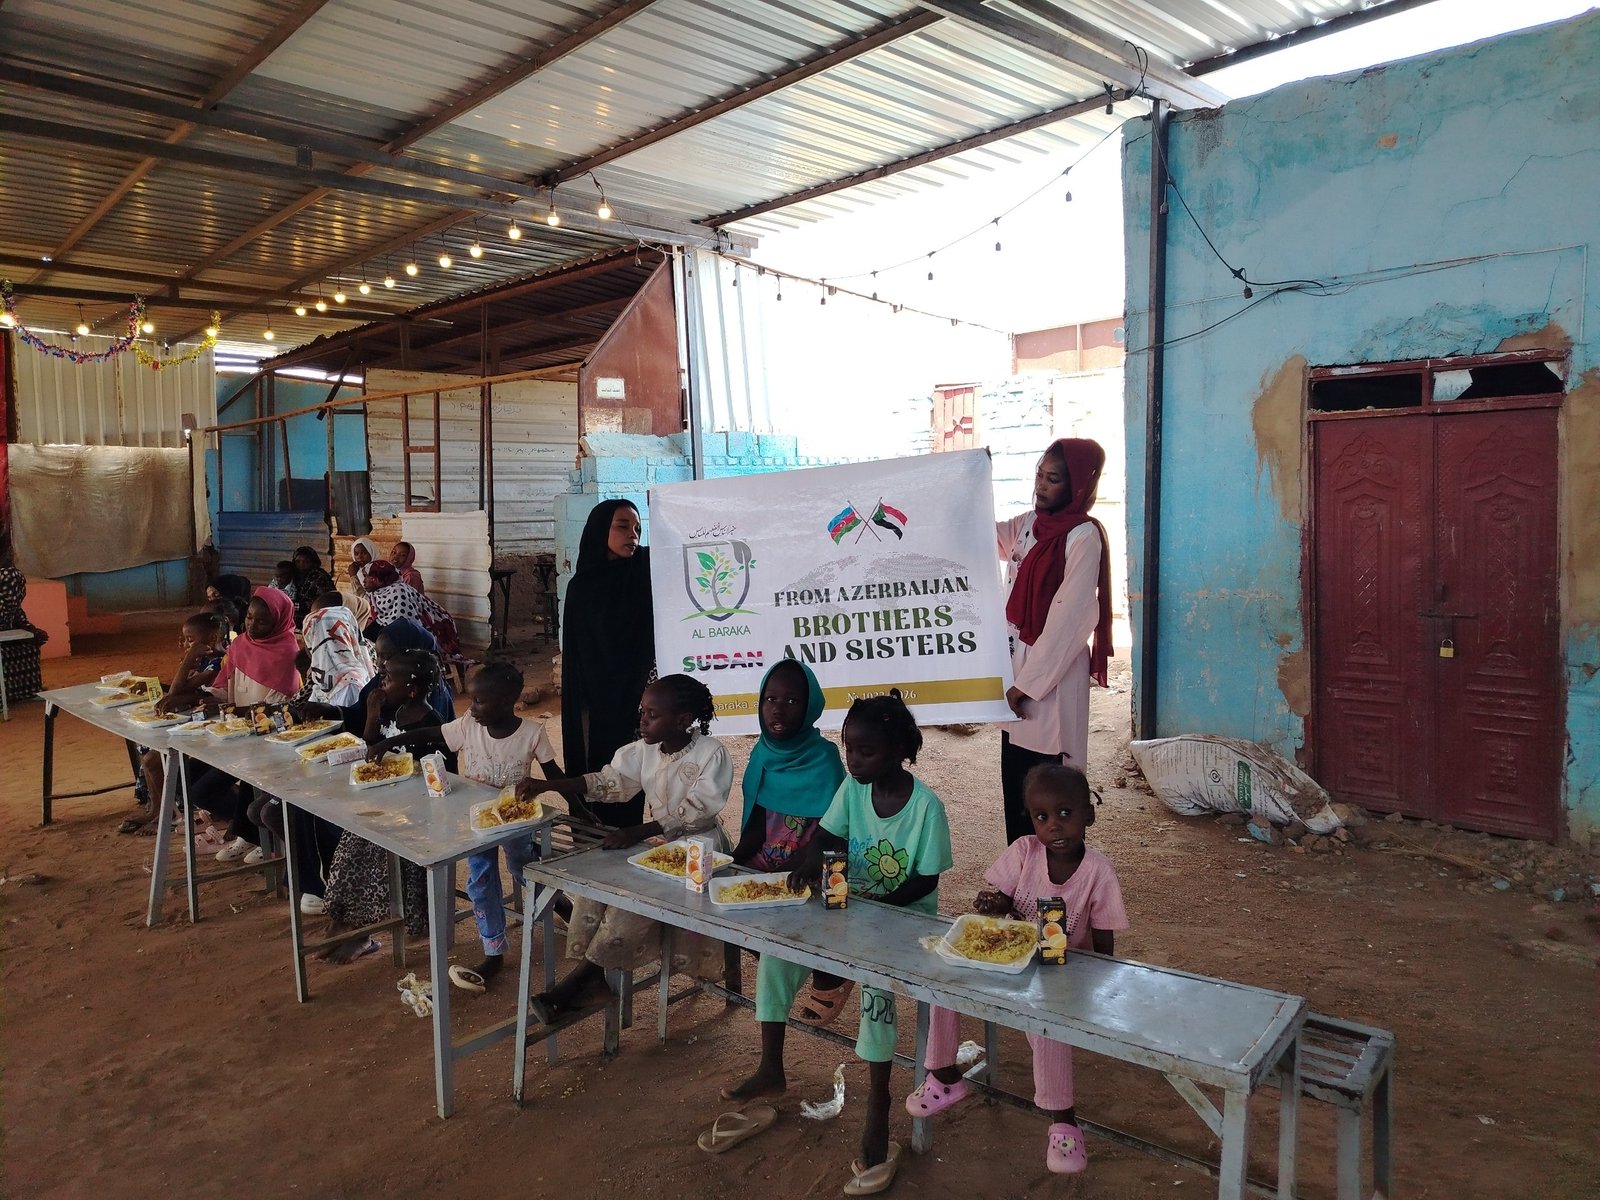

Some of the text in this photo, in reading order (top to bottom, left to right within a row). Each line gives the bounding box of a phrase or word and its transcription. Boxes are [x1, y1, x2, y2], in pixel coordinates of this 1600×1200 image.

[774, 576, 969, 607] FROM AZERBAIJAN
[692, 625, 751, 639] AL BARAKA
[793, 605, 953, 638] BROTHERS
[682, 651, 763, 672] SUDAN
[782, 631, 977, 664] AND SISTERS
